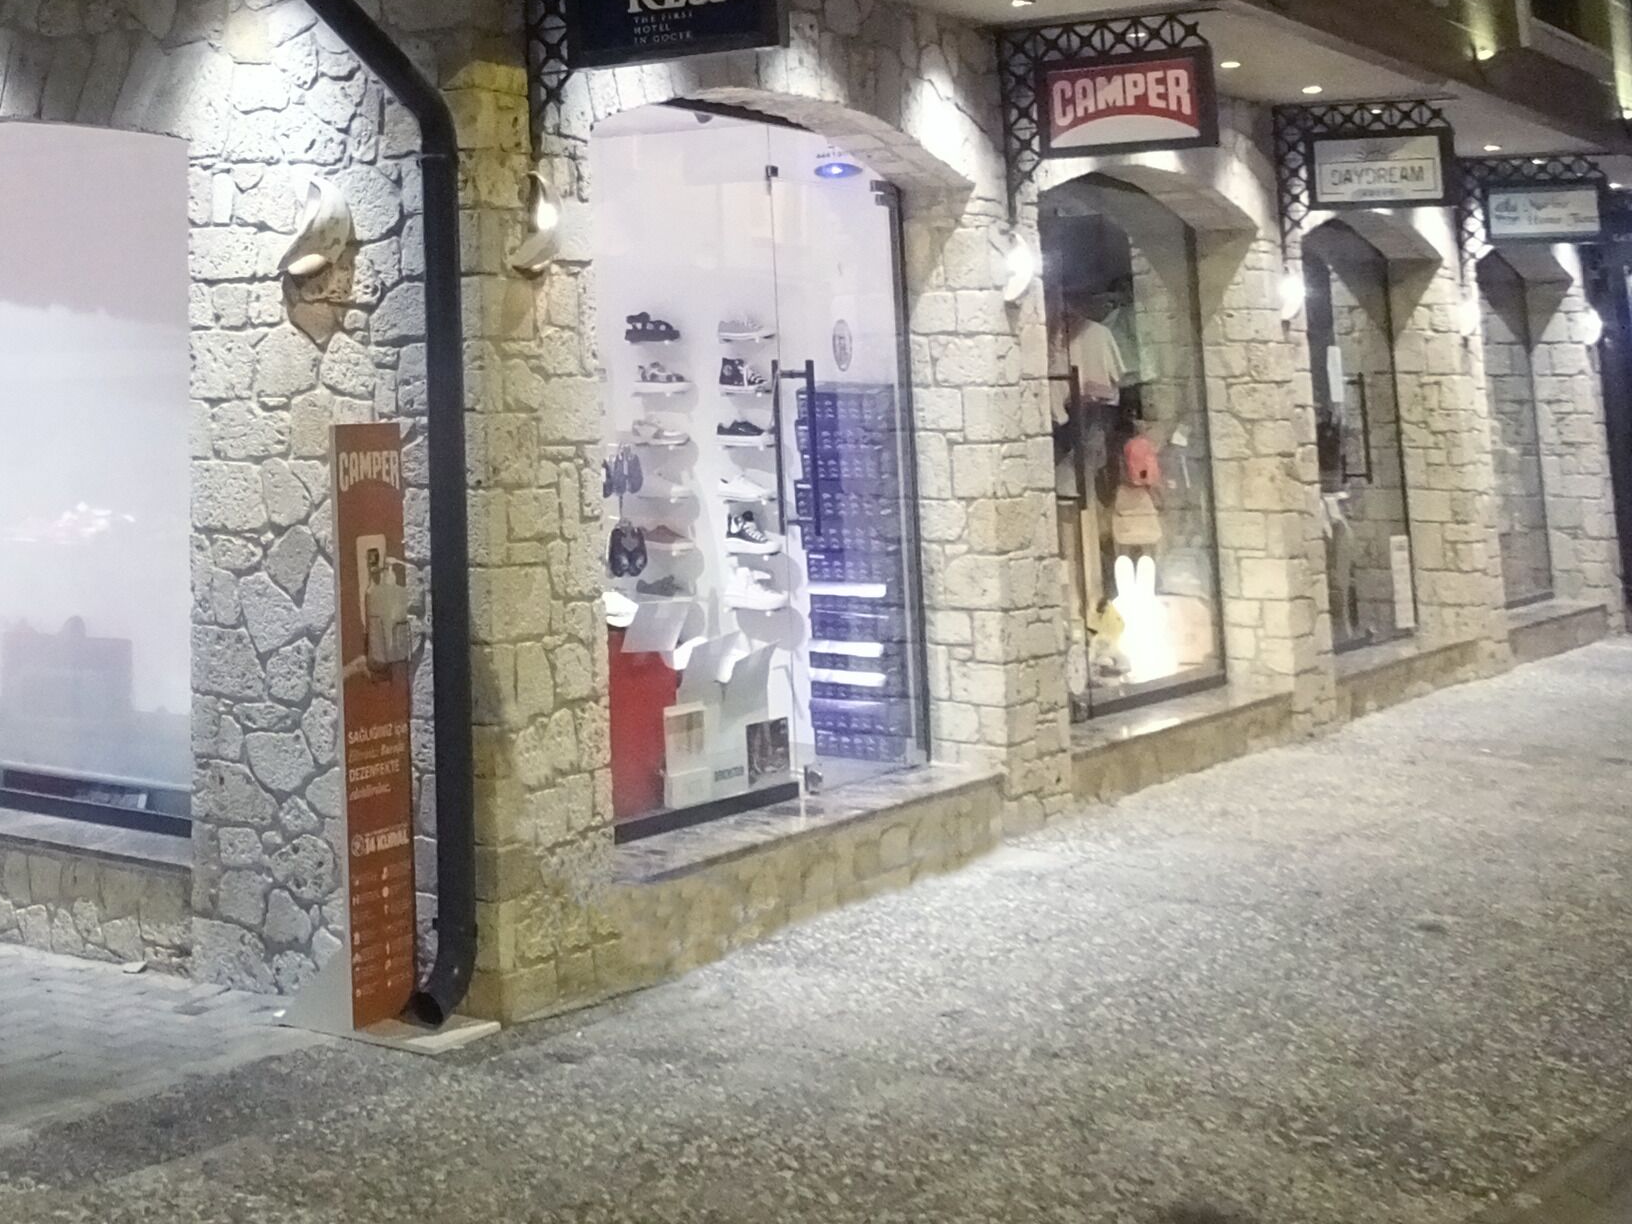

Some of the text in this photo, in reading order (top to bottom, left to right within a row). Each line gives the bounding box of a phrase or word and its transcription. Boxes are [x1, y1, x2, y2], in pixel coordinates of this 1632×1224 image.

[633, 16, 656, 24] THE
[633, 23, 670, 34] HOTEL
[634, 36, 647, 44] IN
[1052, 68, 1192, 126] CAMPER
[1330, 165, 1425, 186] DAYDREAM
[339, 450, 400, 492] CAMPER
